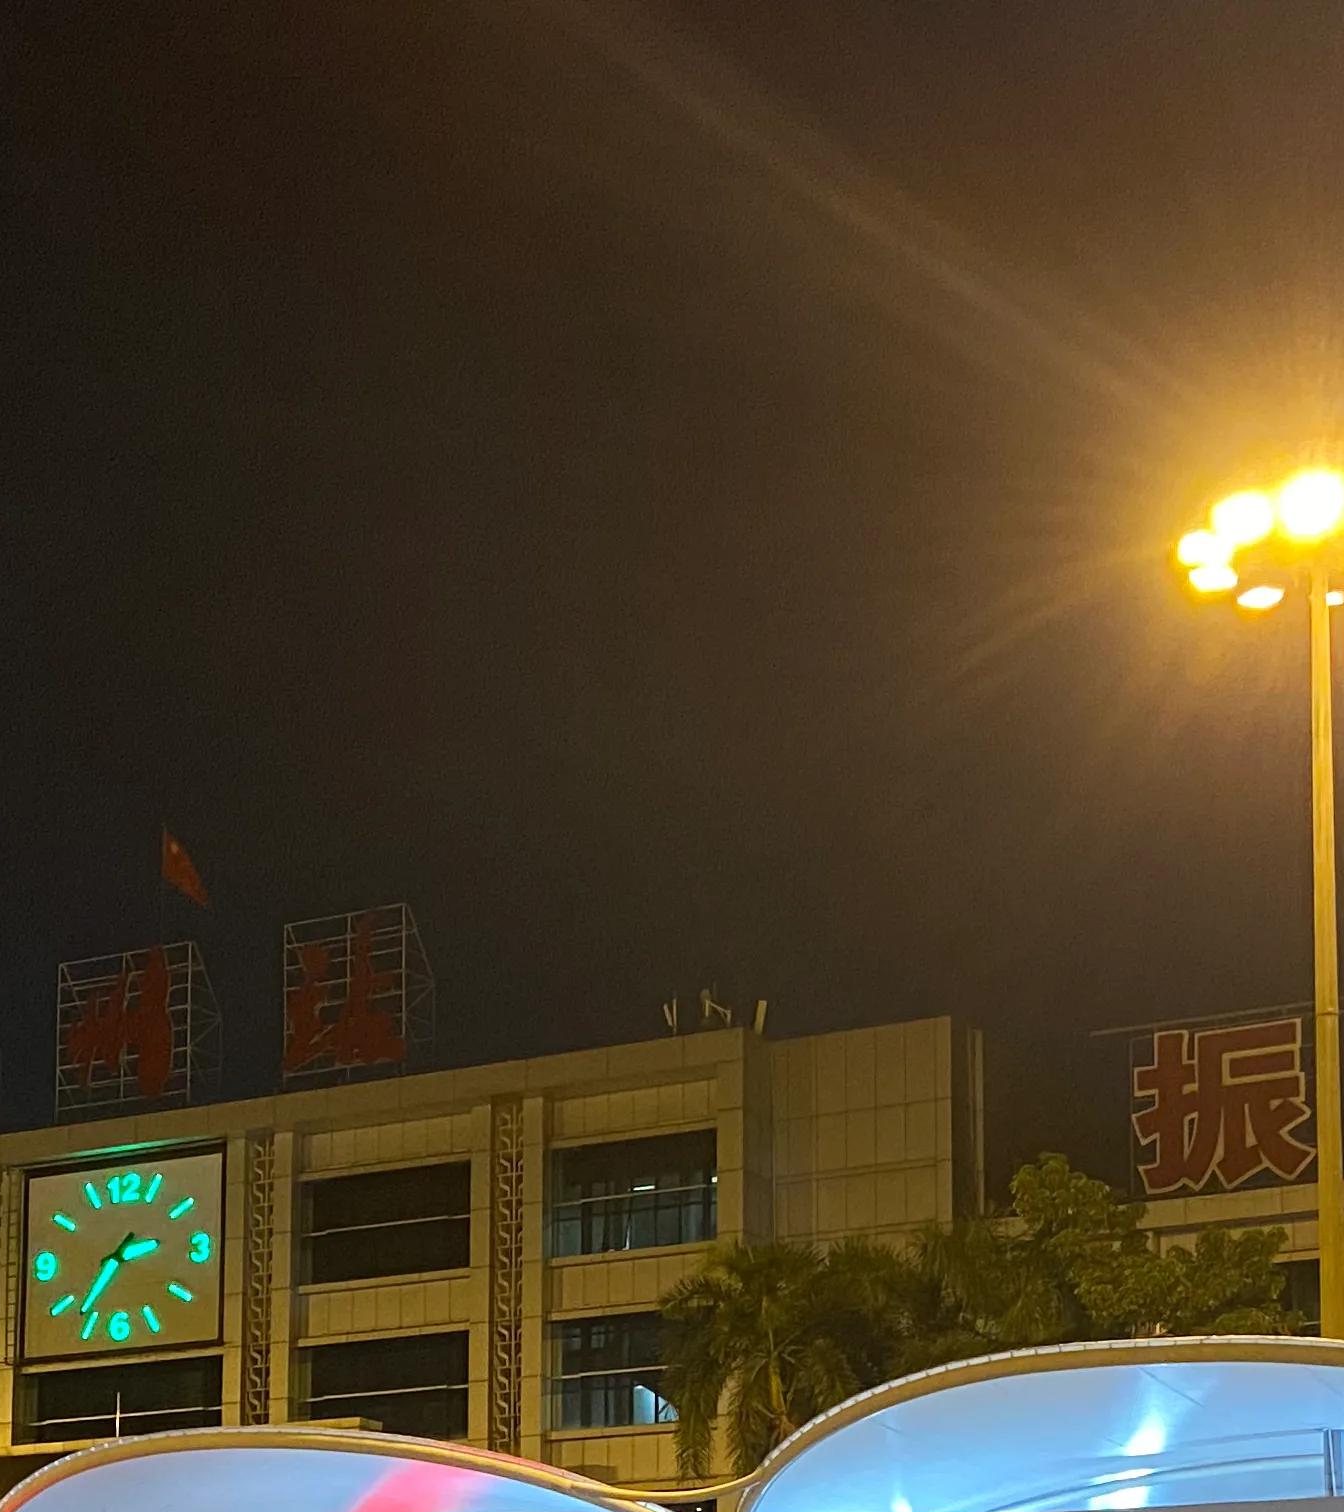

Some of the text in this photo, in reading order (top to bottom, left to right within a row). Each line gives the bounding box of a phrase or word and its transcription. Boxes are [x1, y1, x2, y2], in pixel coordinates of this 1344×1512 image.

[106, 1172, 142, 1204] 12
[188, 1231, 212, 1264] 3
[34, 1251, 58, 1282] 9
[108, 1311, 131, 1342] 6
